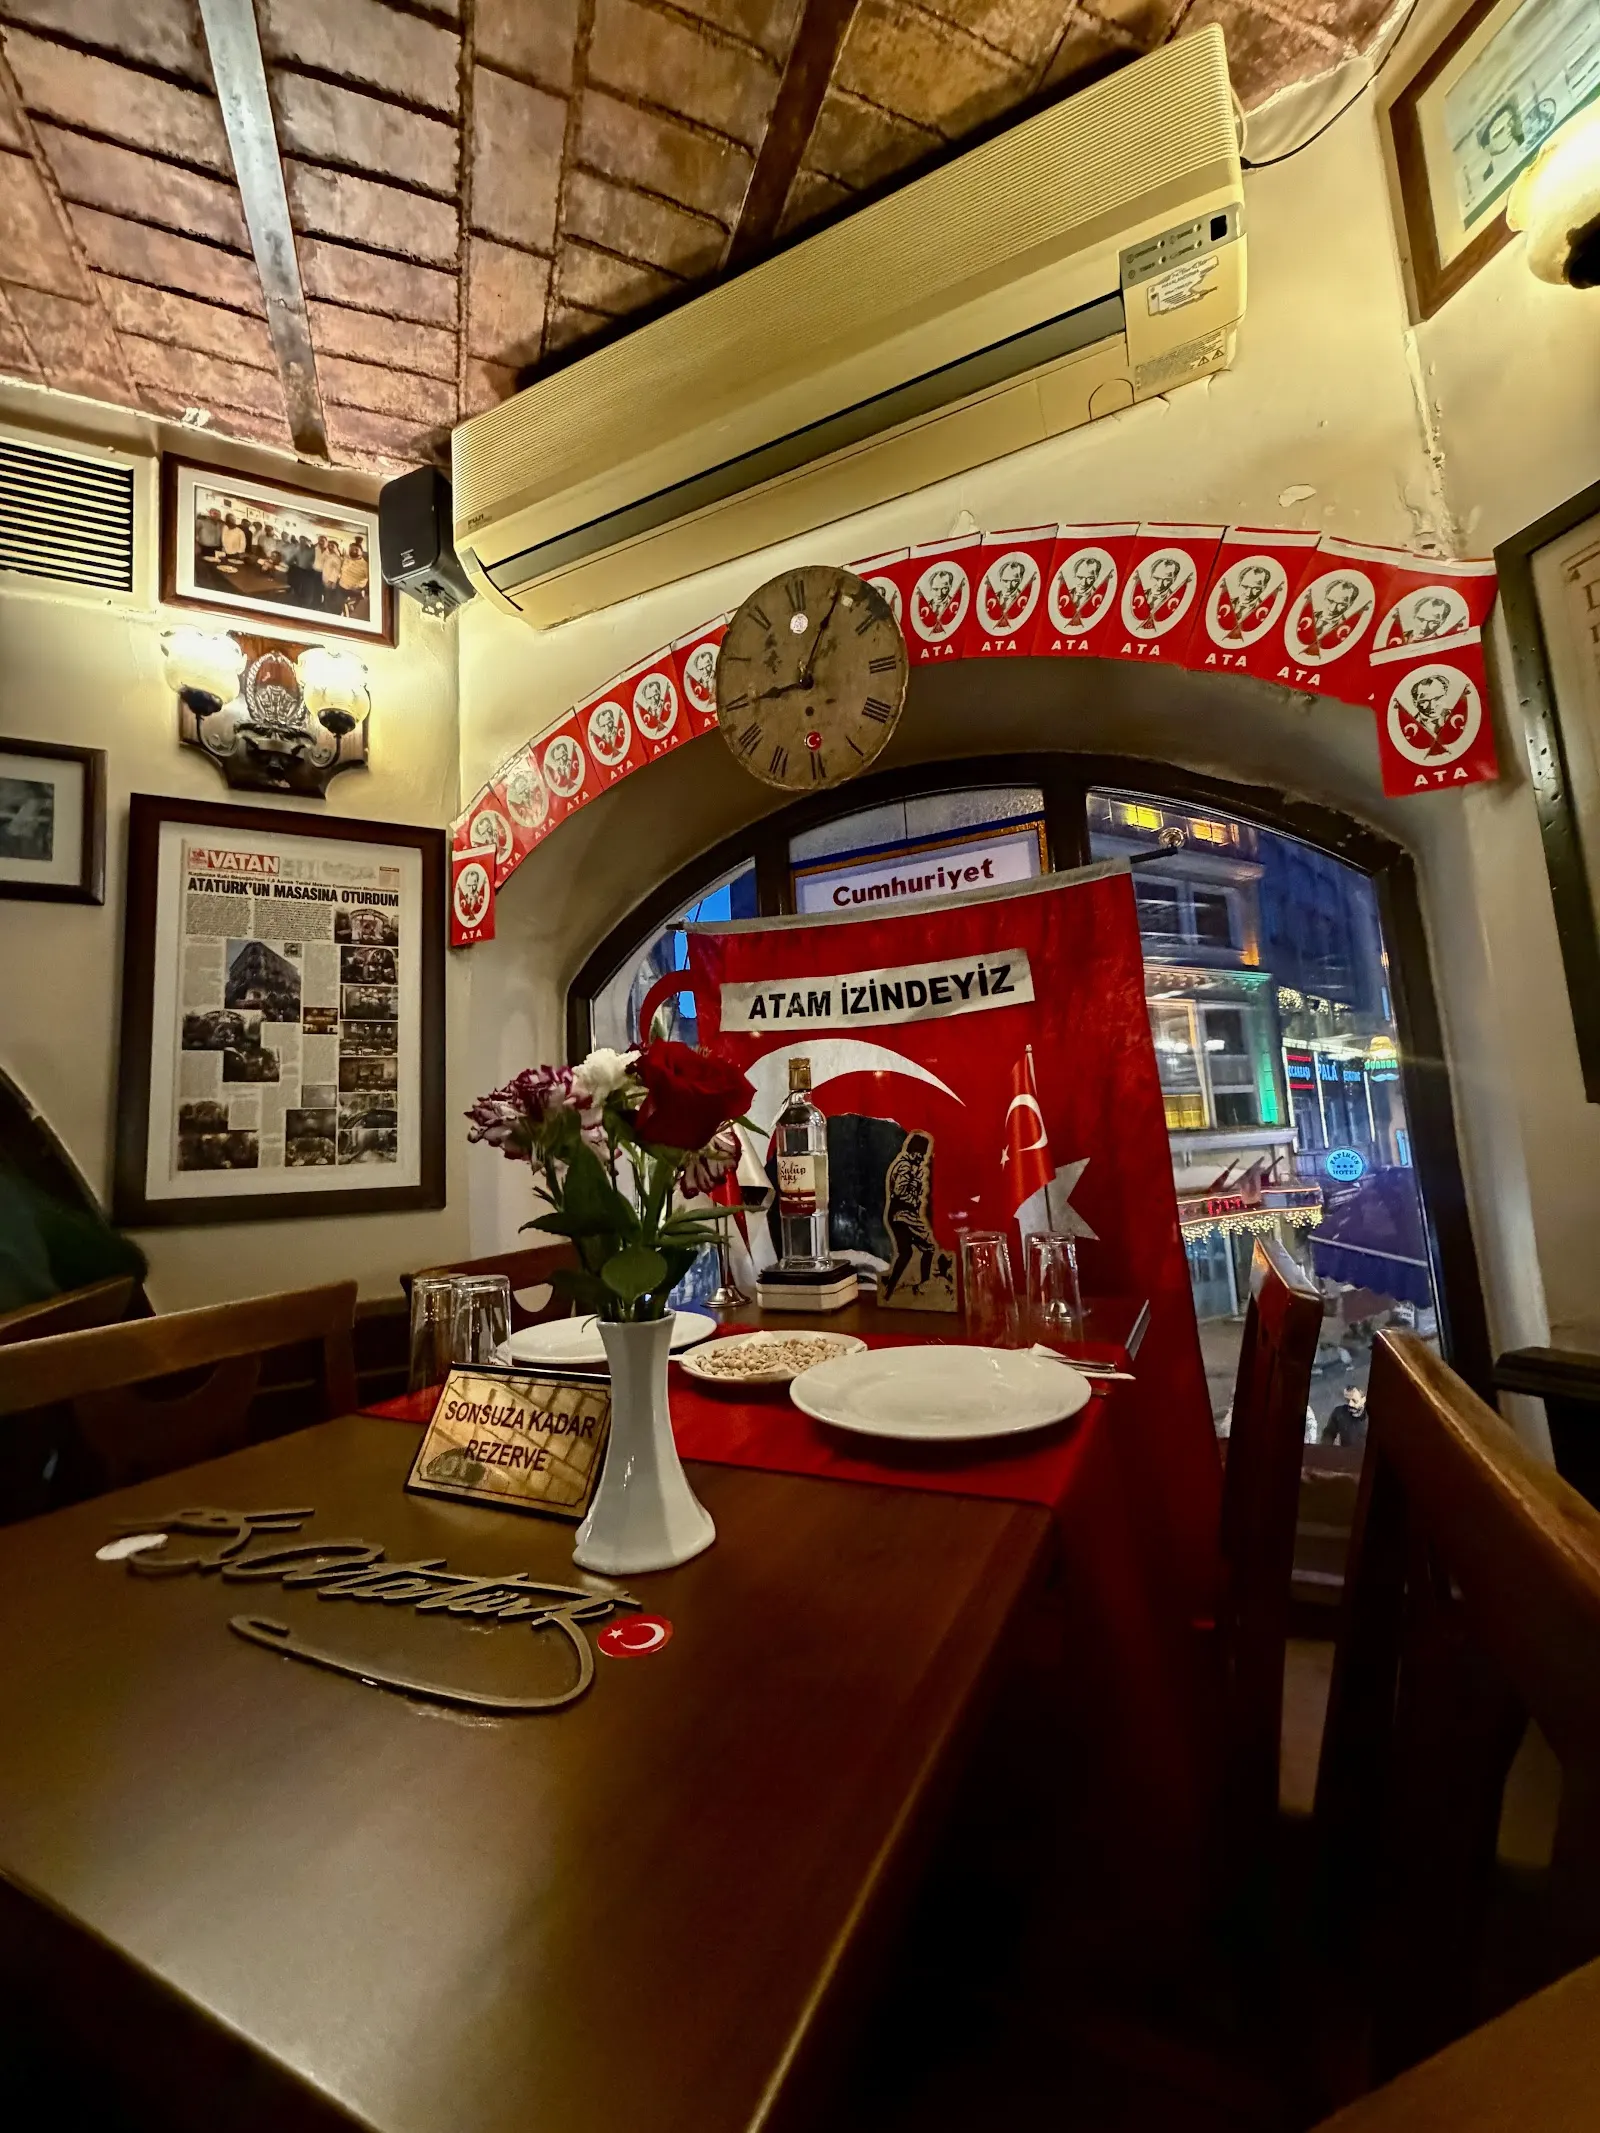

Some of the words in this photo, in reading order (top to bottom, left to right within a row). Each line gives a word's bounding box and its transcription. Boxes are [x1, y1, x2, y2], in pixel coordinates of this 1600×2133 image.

[920, 644, 954, 659] ATA
[981, 640, 1017, 652] ATA
[1051, 639, 1089, 651] ATA
[1120, 642, 1160, 656] ATA
[1204, 652, 1248, 667] ATA
[1276, 665, 1321, 686] ATA
[653, 733, 679, 755] ATA
[609, 759, 635, 781] ATA
[1413, 766, 1469, 787] ATA
[566, 790, 590, 811] ATA
[533, 817, 557, 840] ATA
[209, 851, 280, 874] VATAN
[501, 850, 522, 876] ATA
[832, 858, 995, 907] Cumhuriyet
[274, 886, 338, 902] MASASINA
[342, 891, 399, 907] OTURDUM
[461, 929, 482, 941] ATA
[748, 989, 831, 1020] ATAM
[841, 961, 1015, 1016] İZİNDEYİZ
[445, 1400, 525, 1430] SONSUZA
[525, 1410, 597, 1439] KADAR
[464, 1440, 550, 1472] REZERVE
